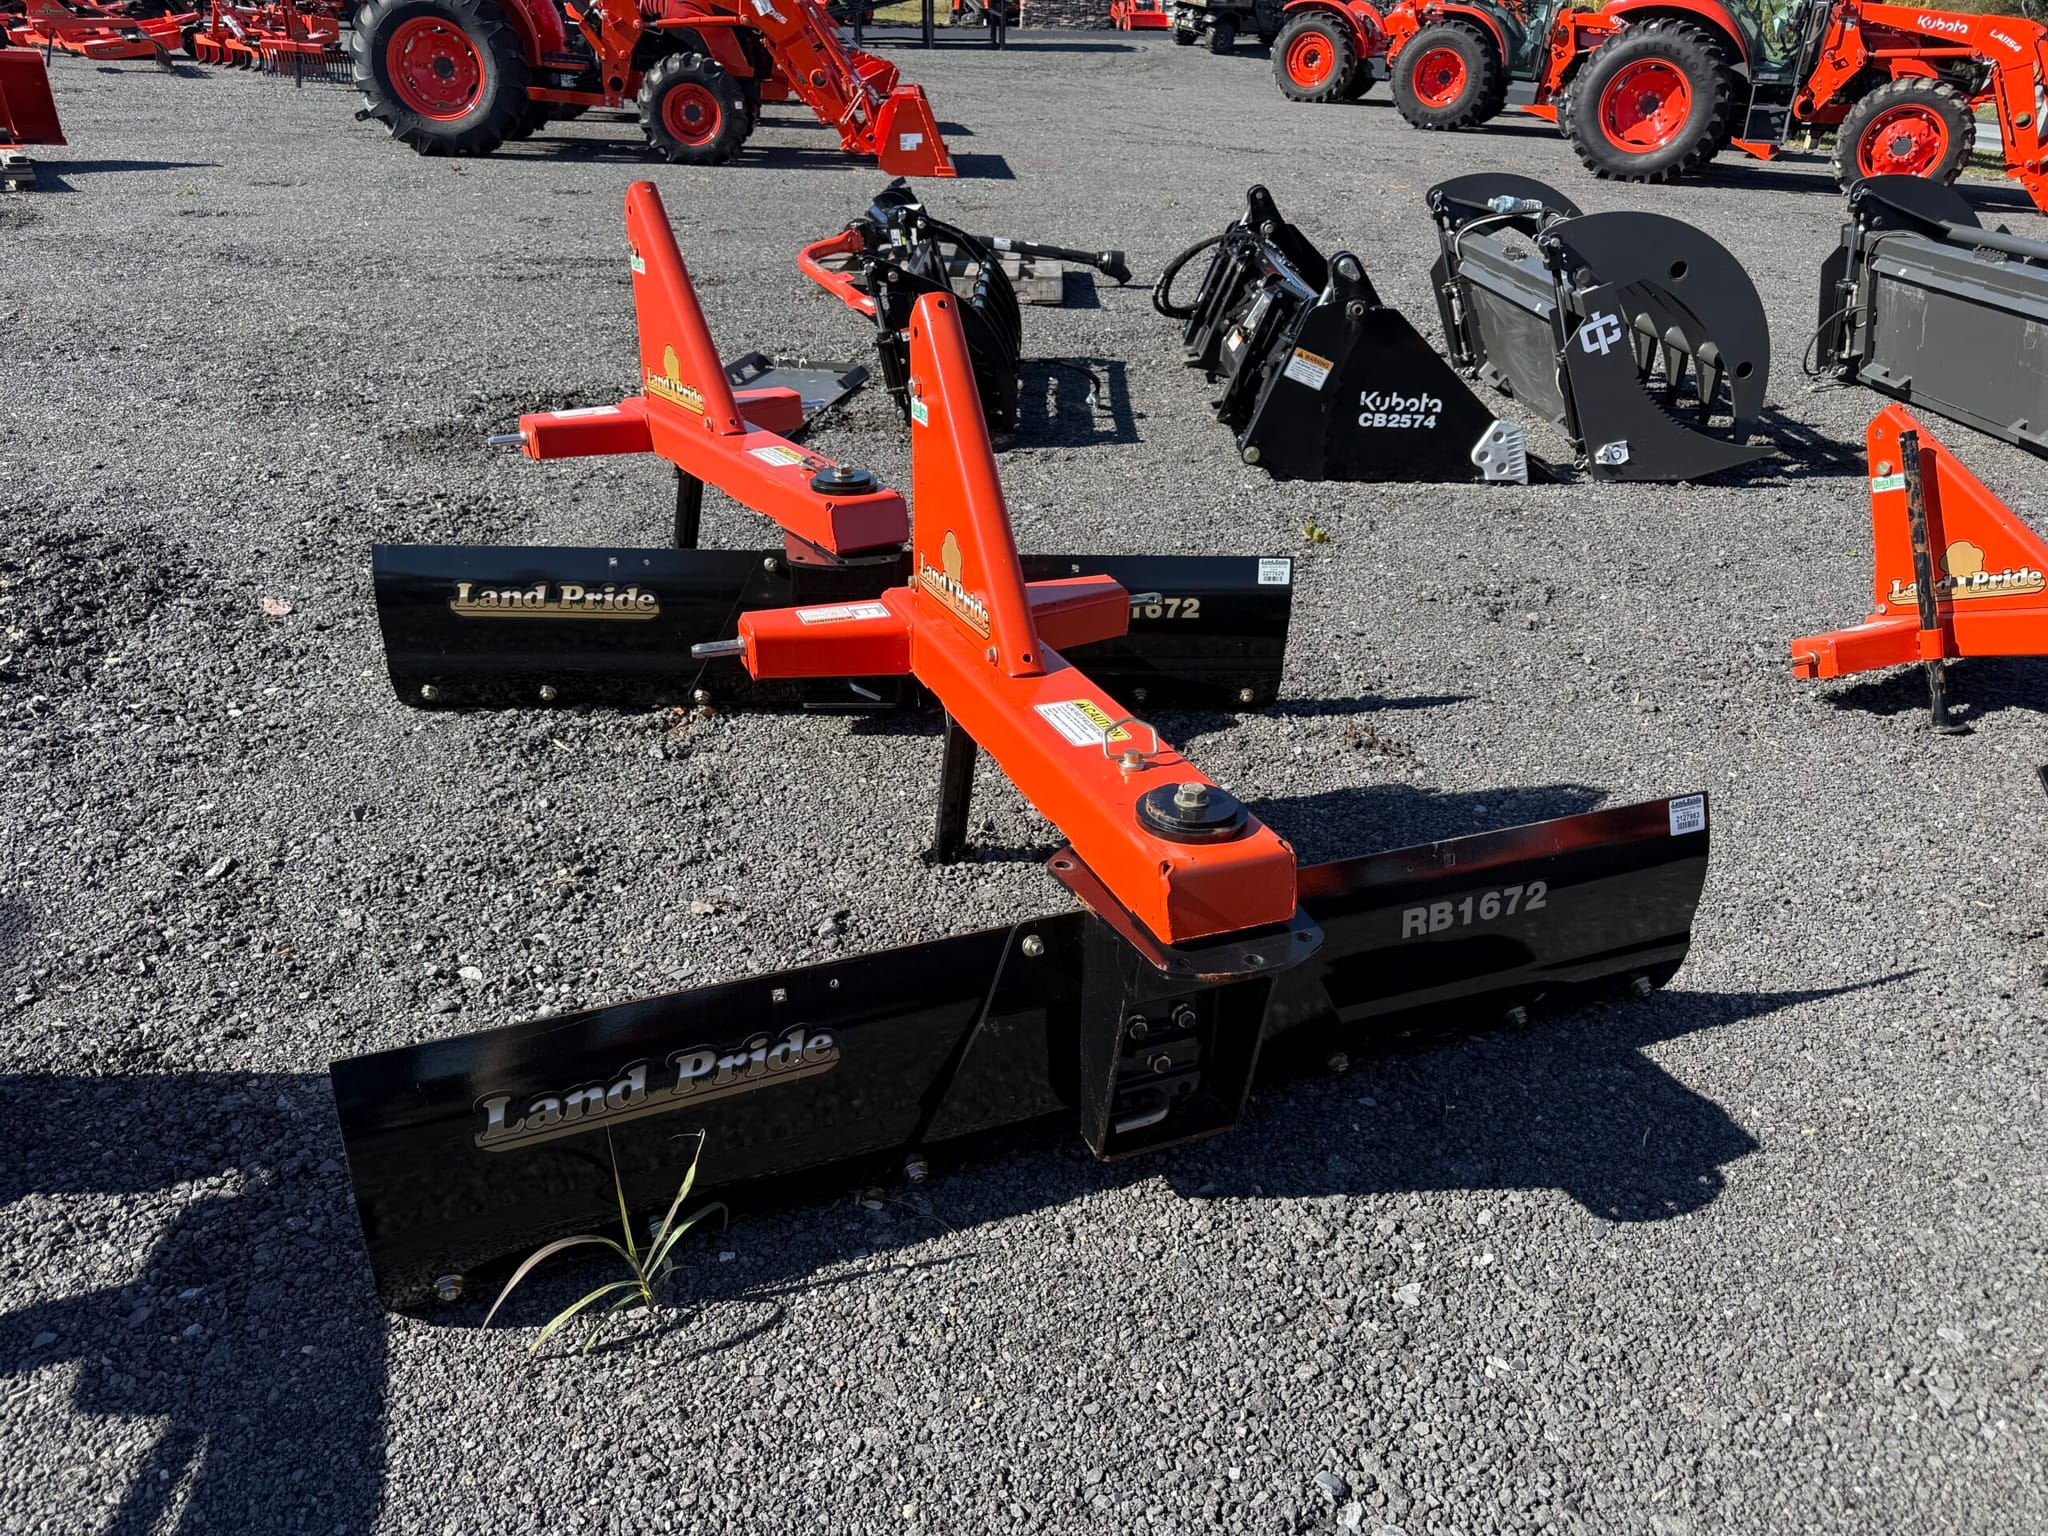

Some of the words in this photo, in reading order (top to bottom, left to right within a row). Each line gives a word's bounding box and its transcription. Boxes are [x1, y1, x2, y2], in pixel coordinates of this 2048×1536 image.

[1917, 15, 1969, 34] Kubota
[646, 365, 669, 391] Land
[676, 379, 703, 407] Pride
[1360, 391, 1442, 412] Kubota
[1358, 412, 1437, 428] CB2574
[455, 582, 548, 609] Land
[559, 584, 656, 612] Pride
[921, 551, 947, 597] Land
[954, 580, 989, 630] Pride
[1890, 576, 1951, 600] Lad
[1970, 566, 2043, 592] Pride
[1401, 880, 1548, 940] RB1672
[478, 1064, 649, 1141] Land
[672, 1027, 836, 1094] Pride
